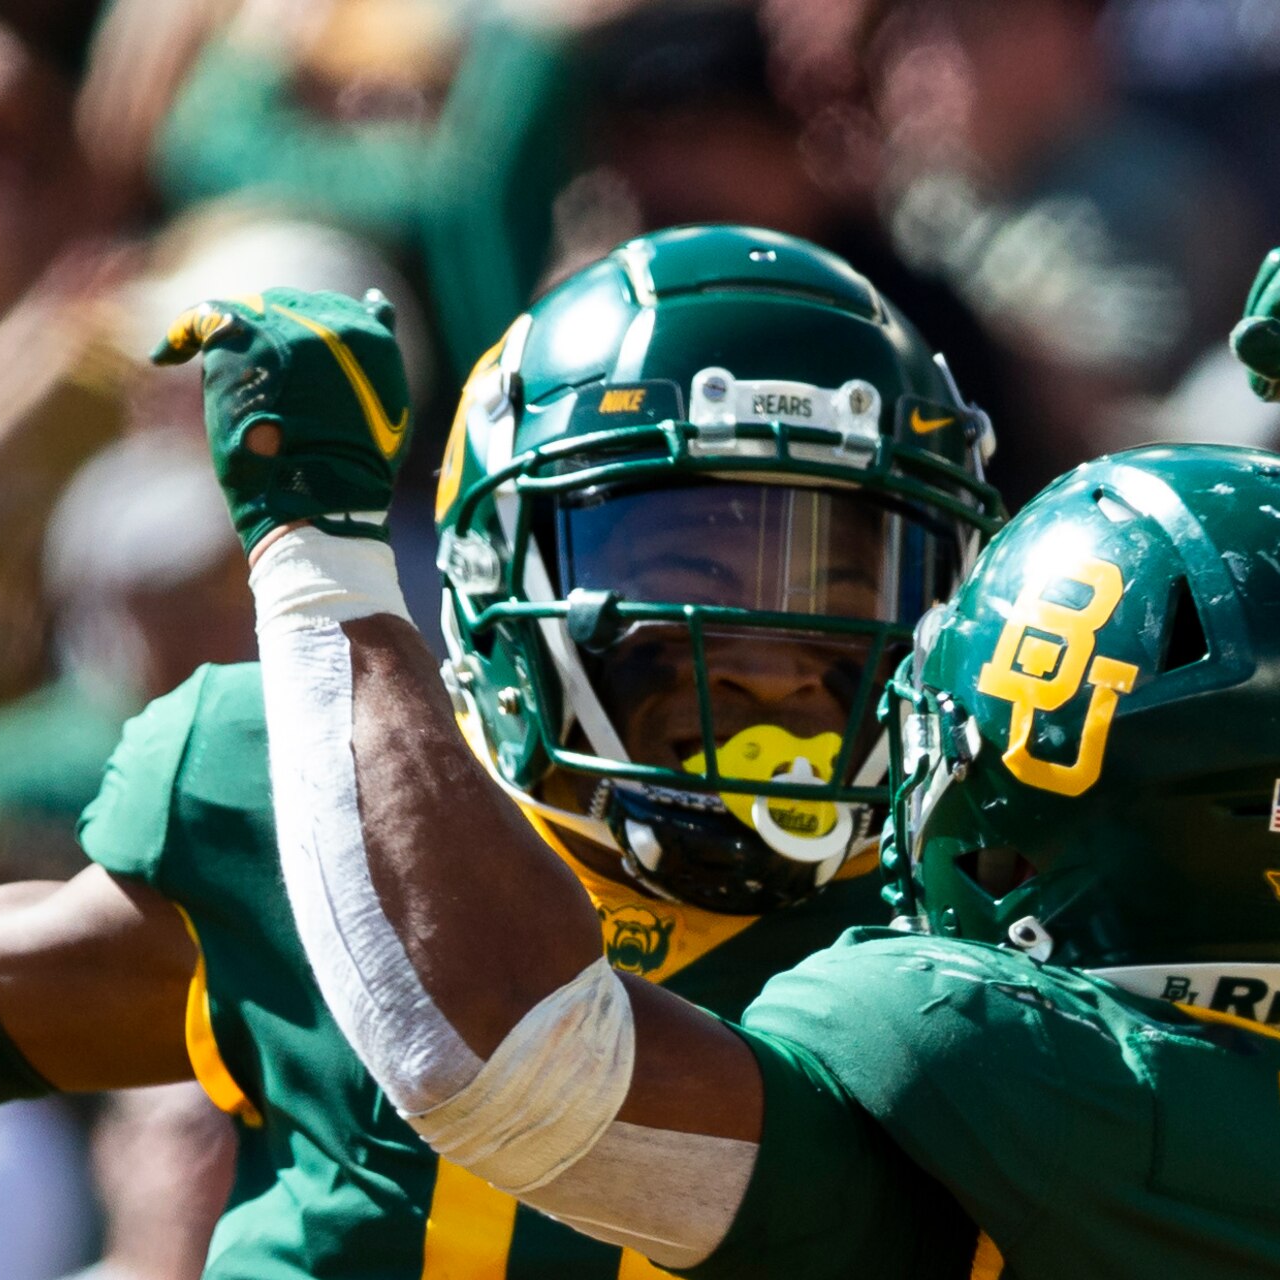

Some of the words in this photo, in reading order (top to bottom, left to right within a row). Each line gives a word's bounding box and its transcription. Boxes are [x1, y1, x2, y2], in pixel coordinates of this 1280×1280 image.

[598, 389, 646, 413] NIKE
[752, 394, 813, 418] BEARS
[977, 555, 1140, 797] BU
